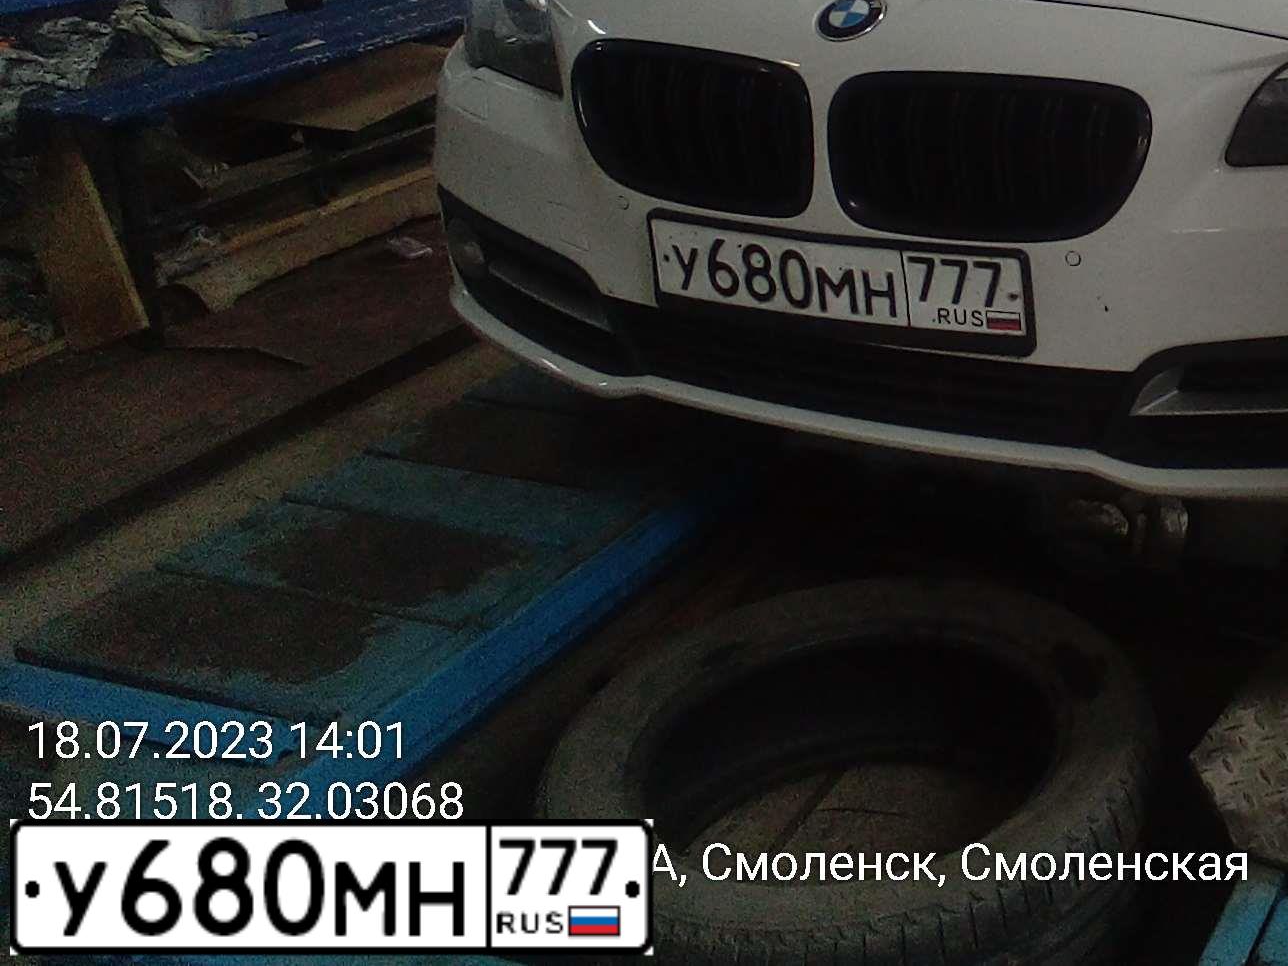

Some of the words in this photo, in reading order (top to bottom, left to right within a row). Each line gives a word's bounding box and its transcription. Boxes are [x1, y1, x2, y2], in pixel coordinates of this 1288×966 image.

[671, 238, 898, 319] У680МН
[907, 256, 1002, 308] 777
[936, 307, 985, 328] RUS
